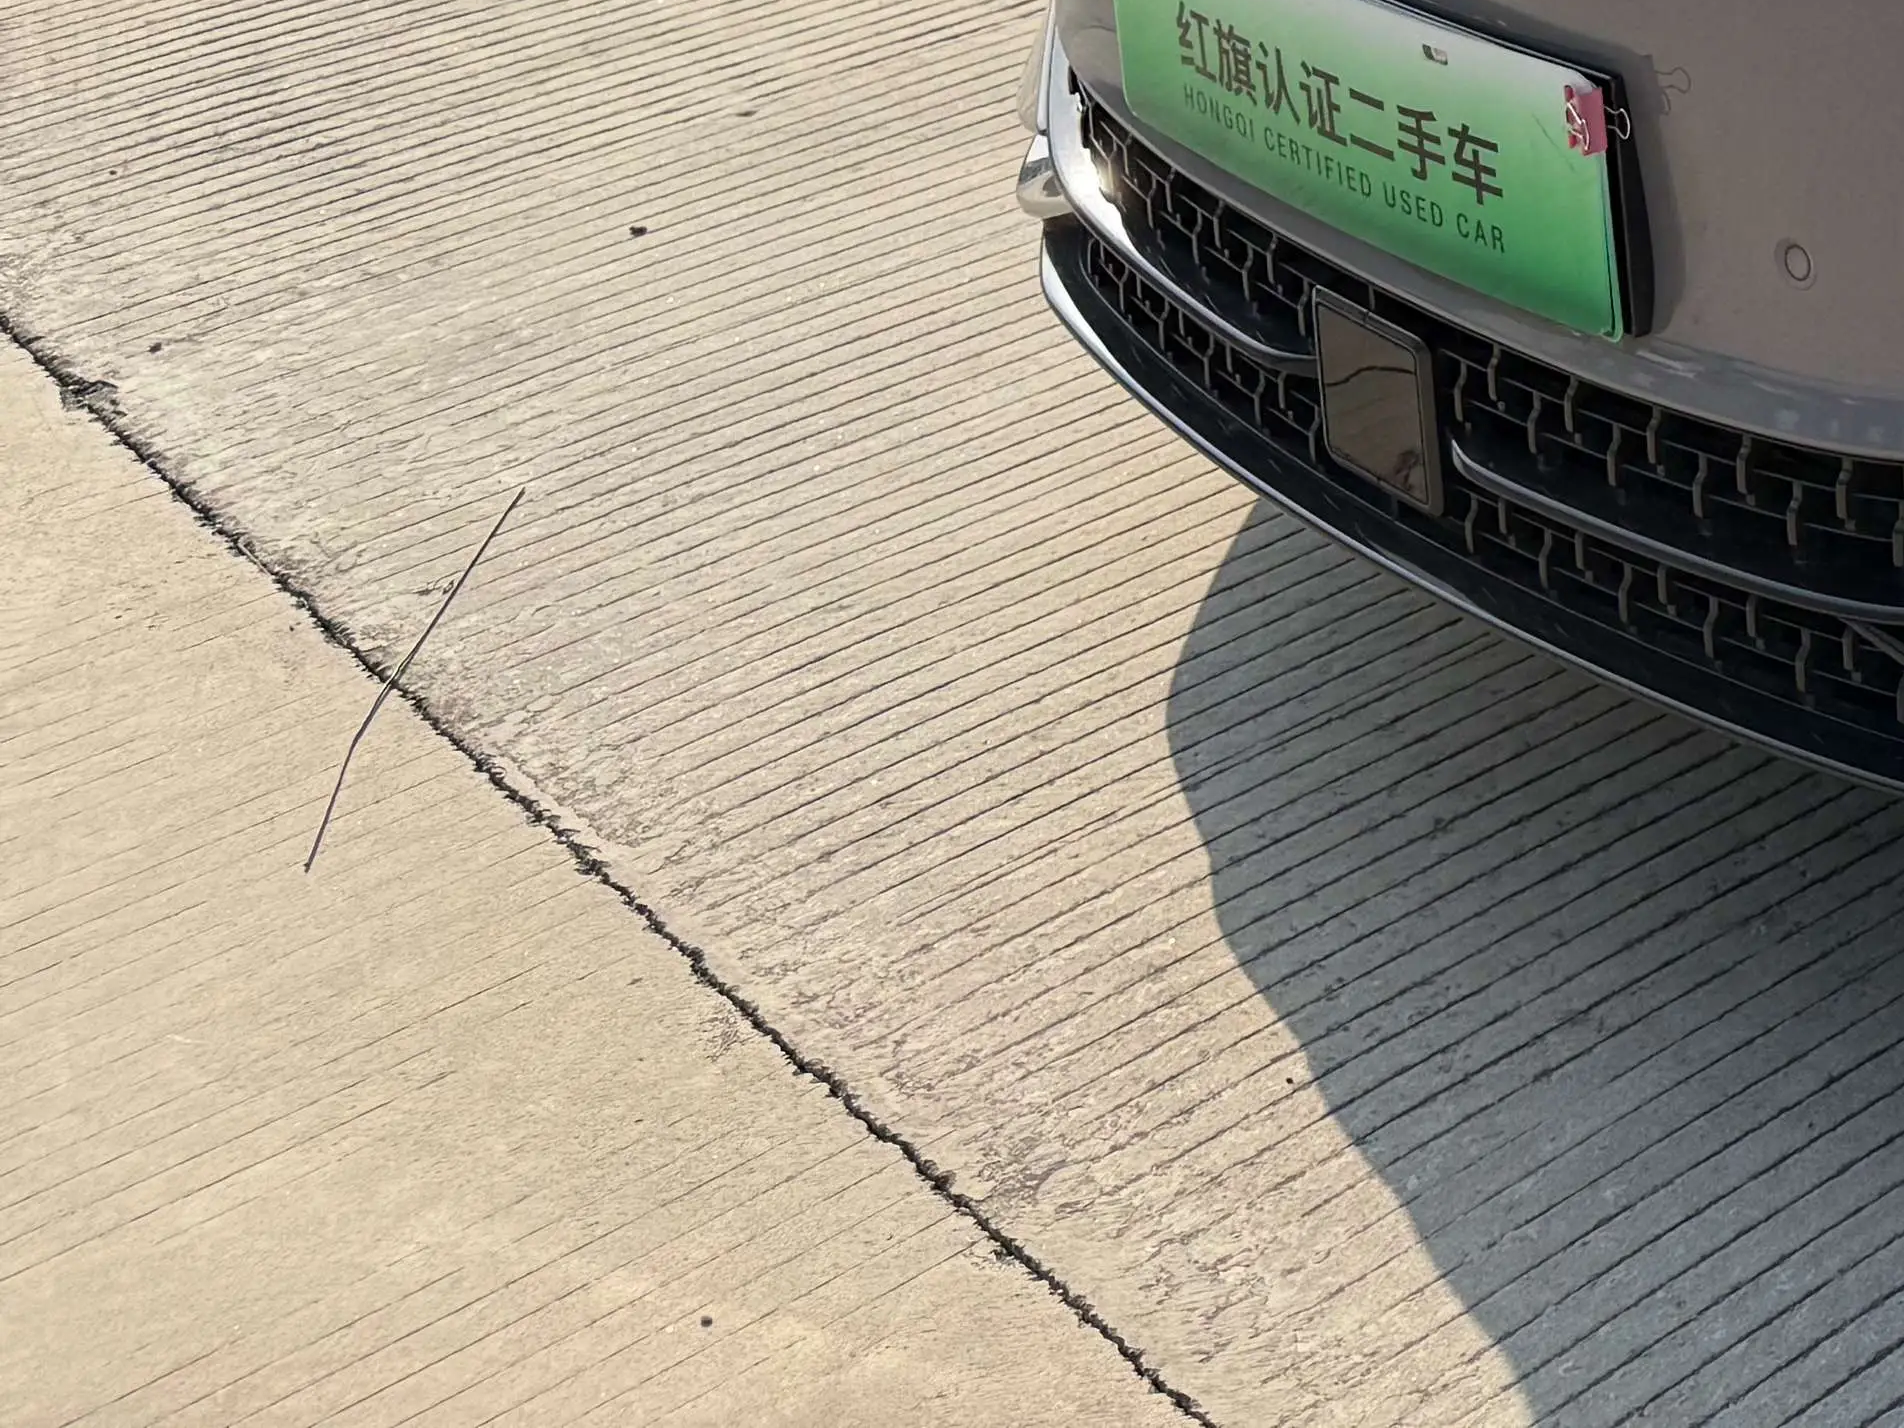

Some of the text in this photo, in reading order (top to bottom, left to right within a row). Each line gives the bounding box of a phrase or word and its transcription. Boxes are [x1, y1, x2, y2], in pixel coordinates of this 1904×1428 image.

[1175, 0, 1504, 206] 红旗认证二手车
[1183, 85, 1505, 253] HONGQI CERTIFIED USED CAR
